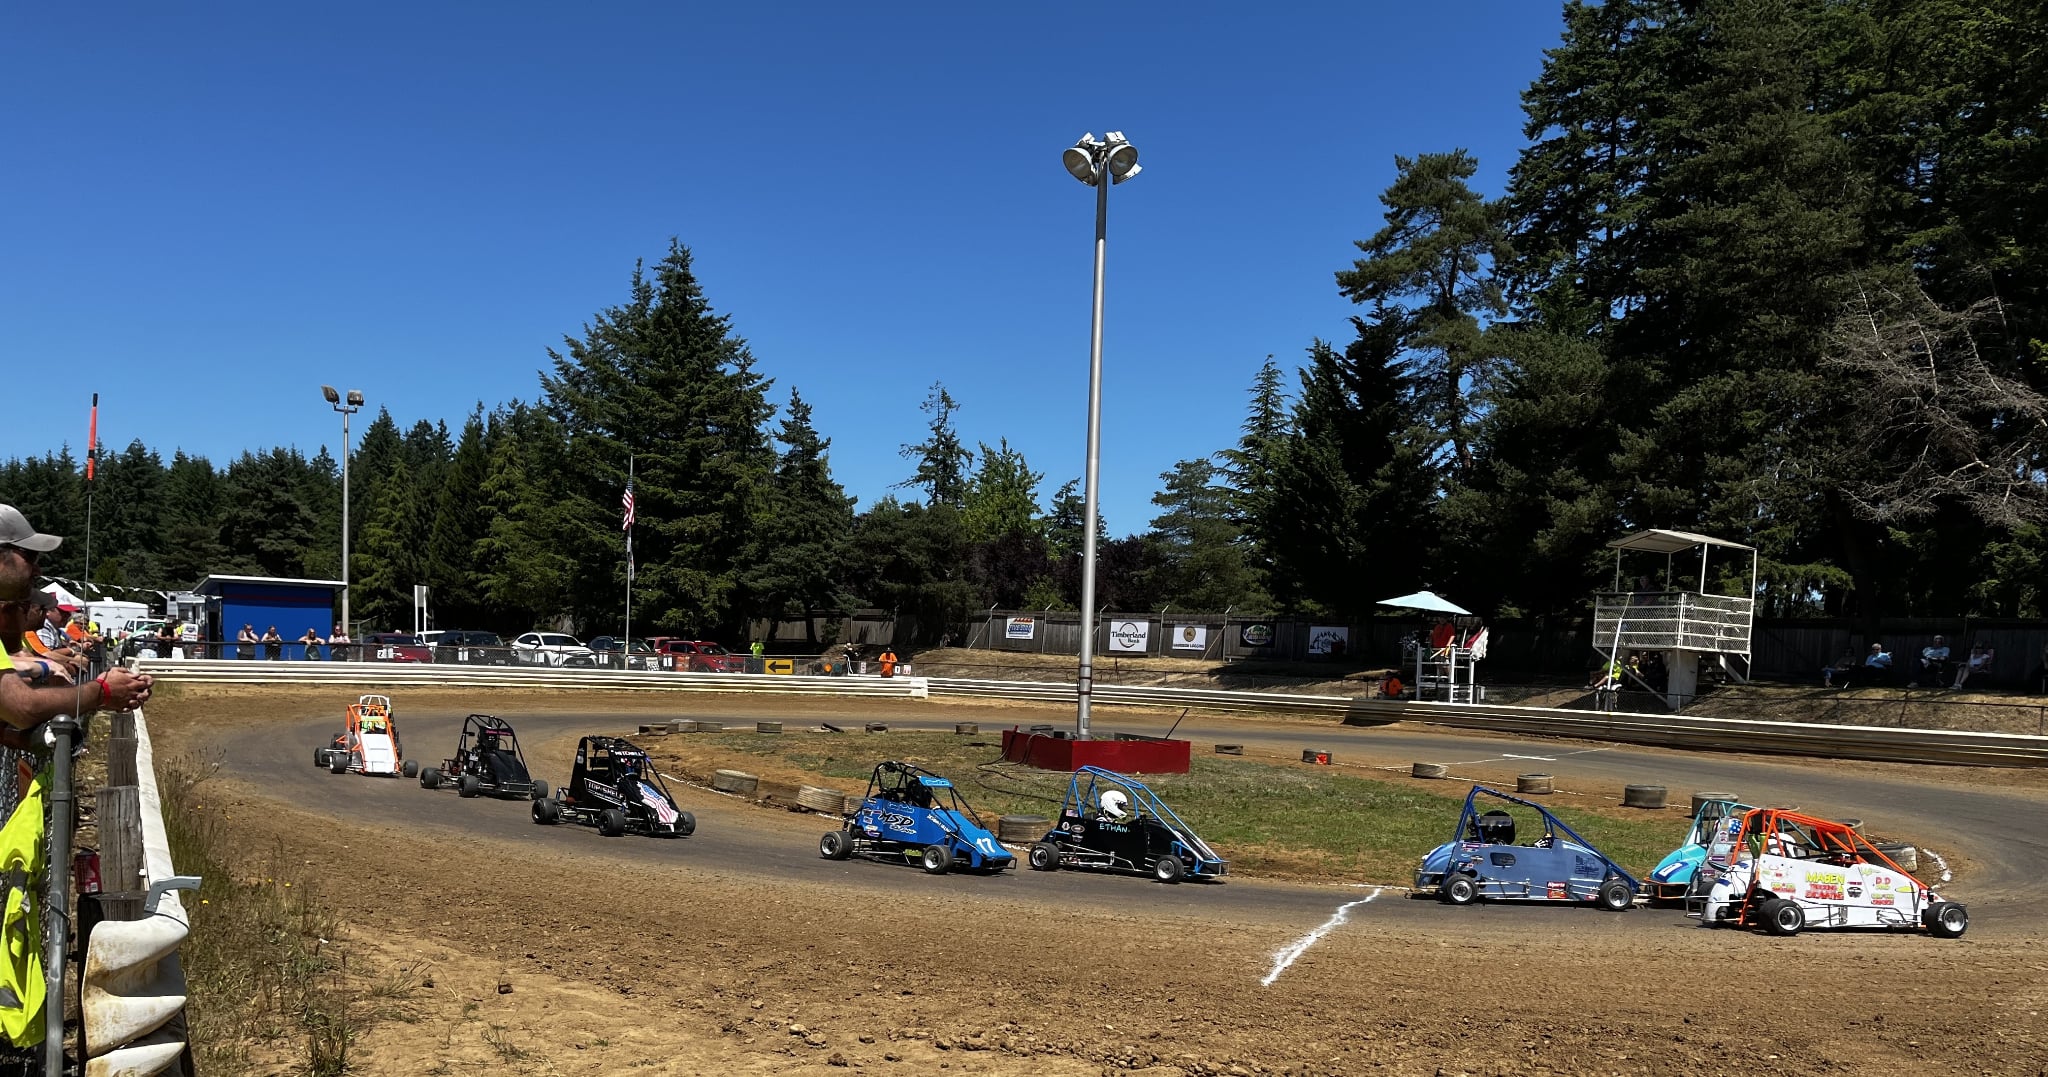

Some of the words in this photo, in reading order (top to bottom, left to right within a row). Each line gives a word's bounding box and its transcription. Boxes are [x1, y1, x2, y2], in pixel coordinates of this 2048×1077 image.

[1111, 631, 1146, 639] Timberland
[588, 782, 600, 791] TOP
[603, 788, 623, 799] SHELF
[878, 811, 914, 826] MSD
[1099, 823, 1128, 832] ETHAN
[976, 837, 996, 853] 17
[1805, 871, 1845, 884] MABEN
